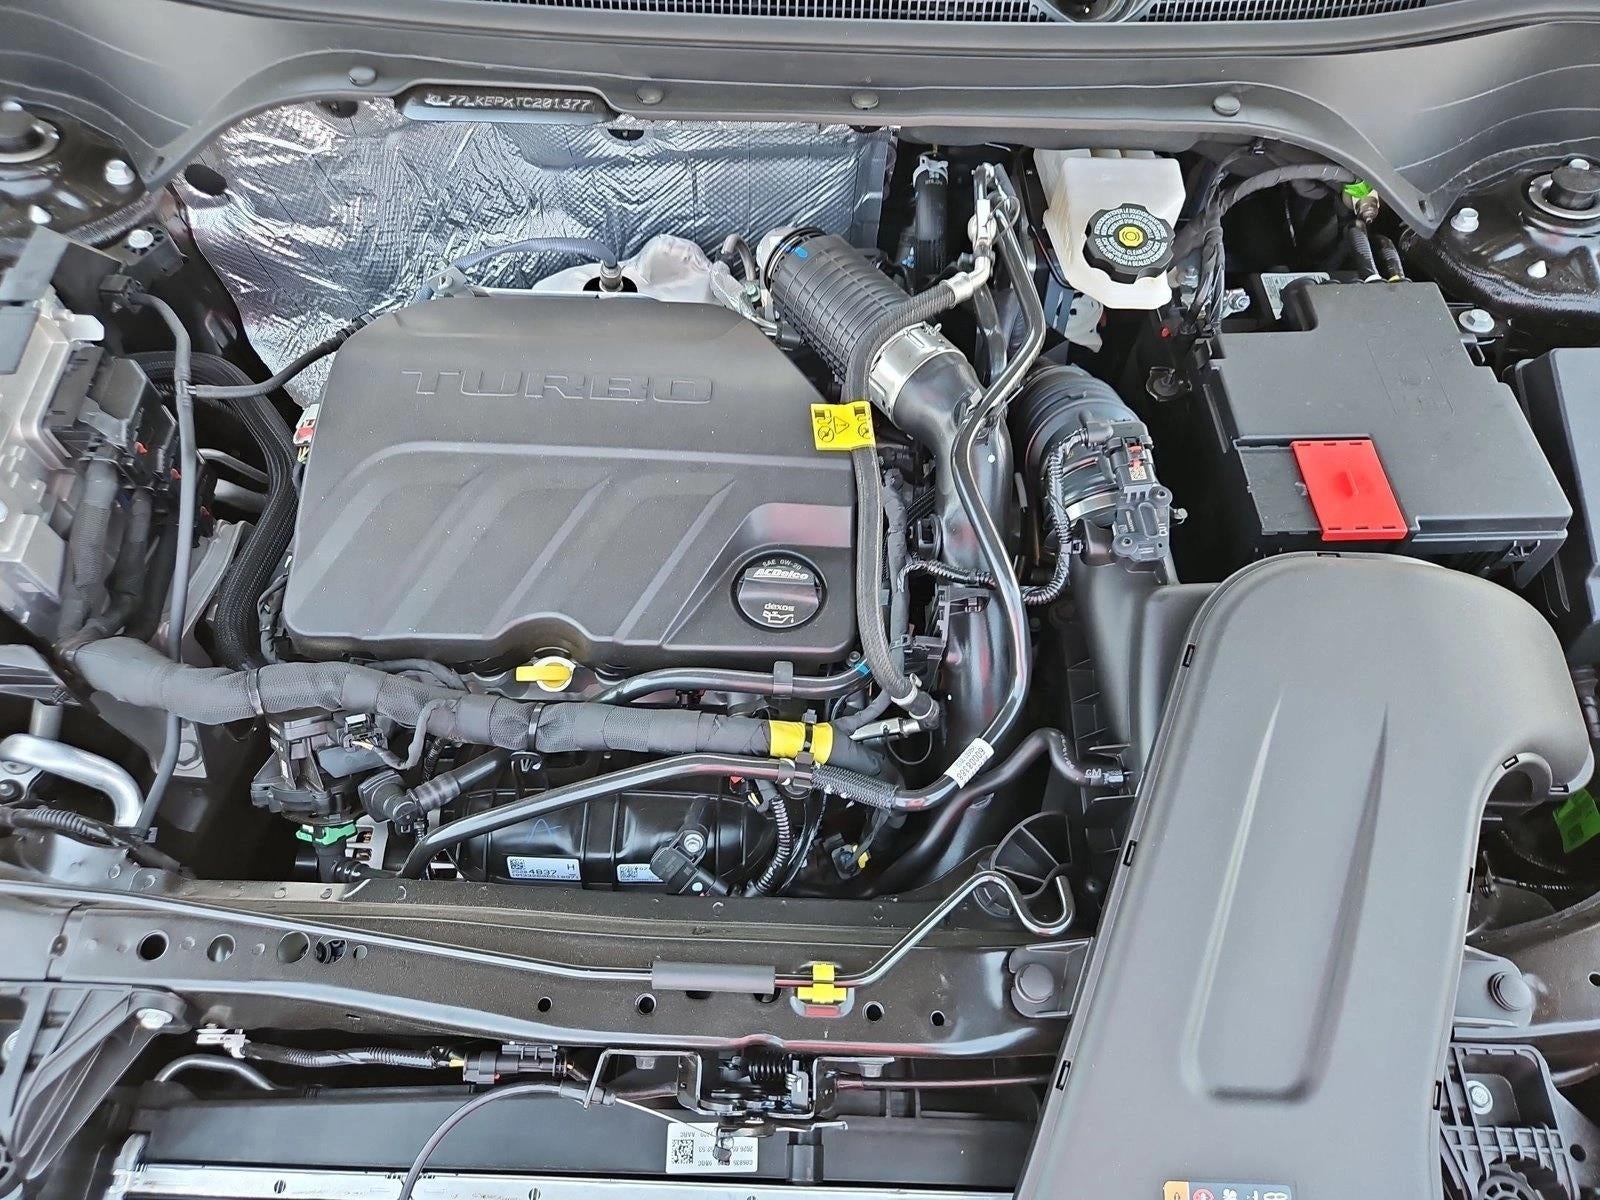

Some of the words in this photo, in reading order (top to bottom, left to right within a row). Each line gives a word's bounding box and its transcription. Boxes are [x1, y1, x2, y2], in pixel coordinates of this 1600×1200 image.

[1111, 257, 1127, 266] FROM
[400, 370, 713, 405] TURBO
[762, 559, 776, 568] SAE
[753, 568, 808, 580] ACDelco
[764, 602, 795, 612] dexos
[1086, 768, 1102, 778] GM
